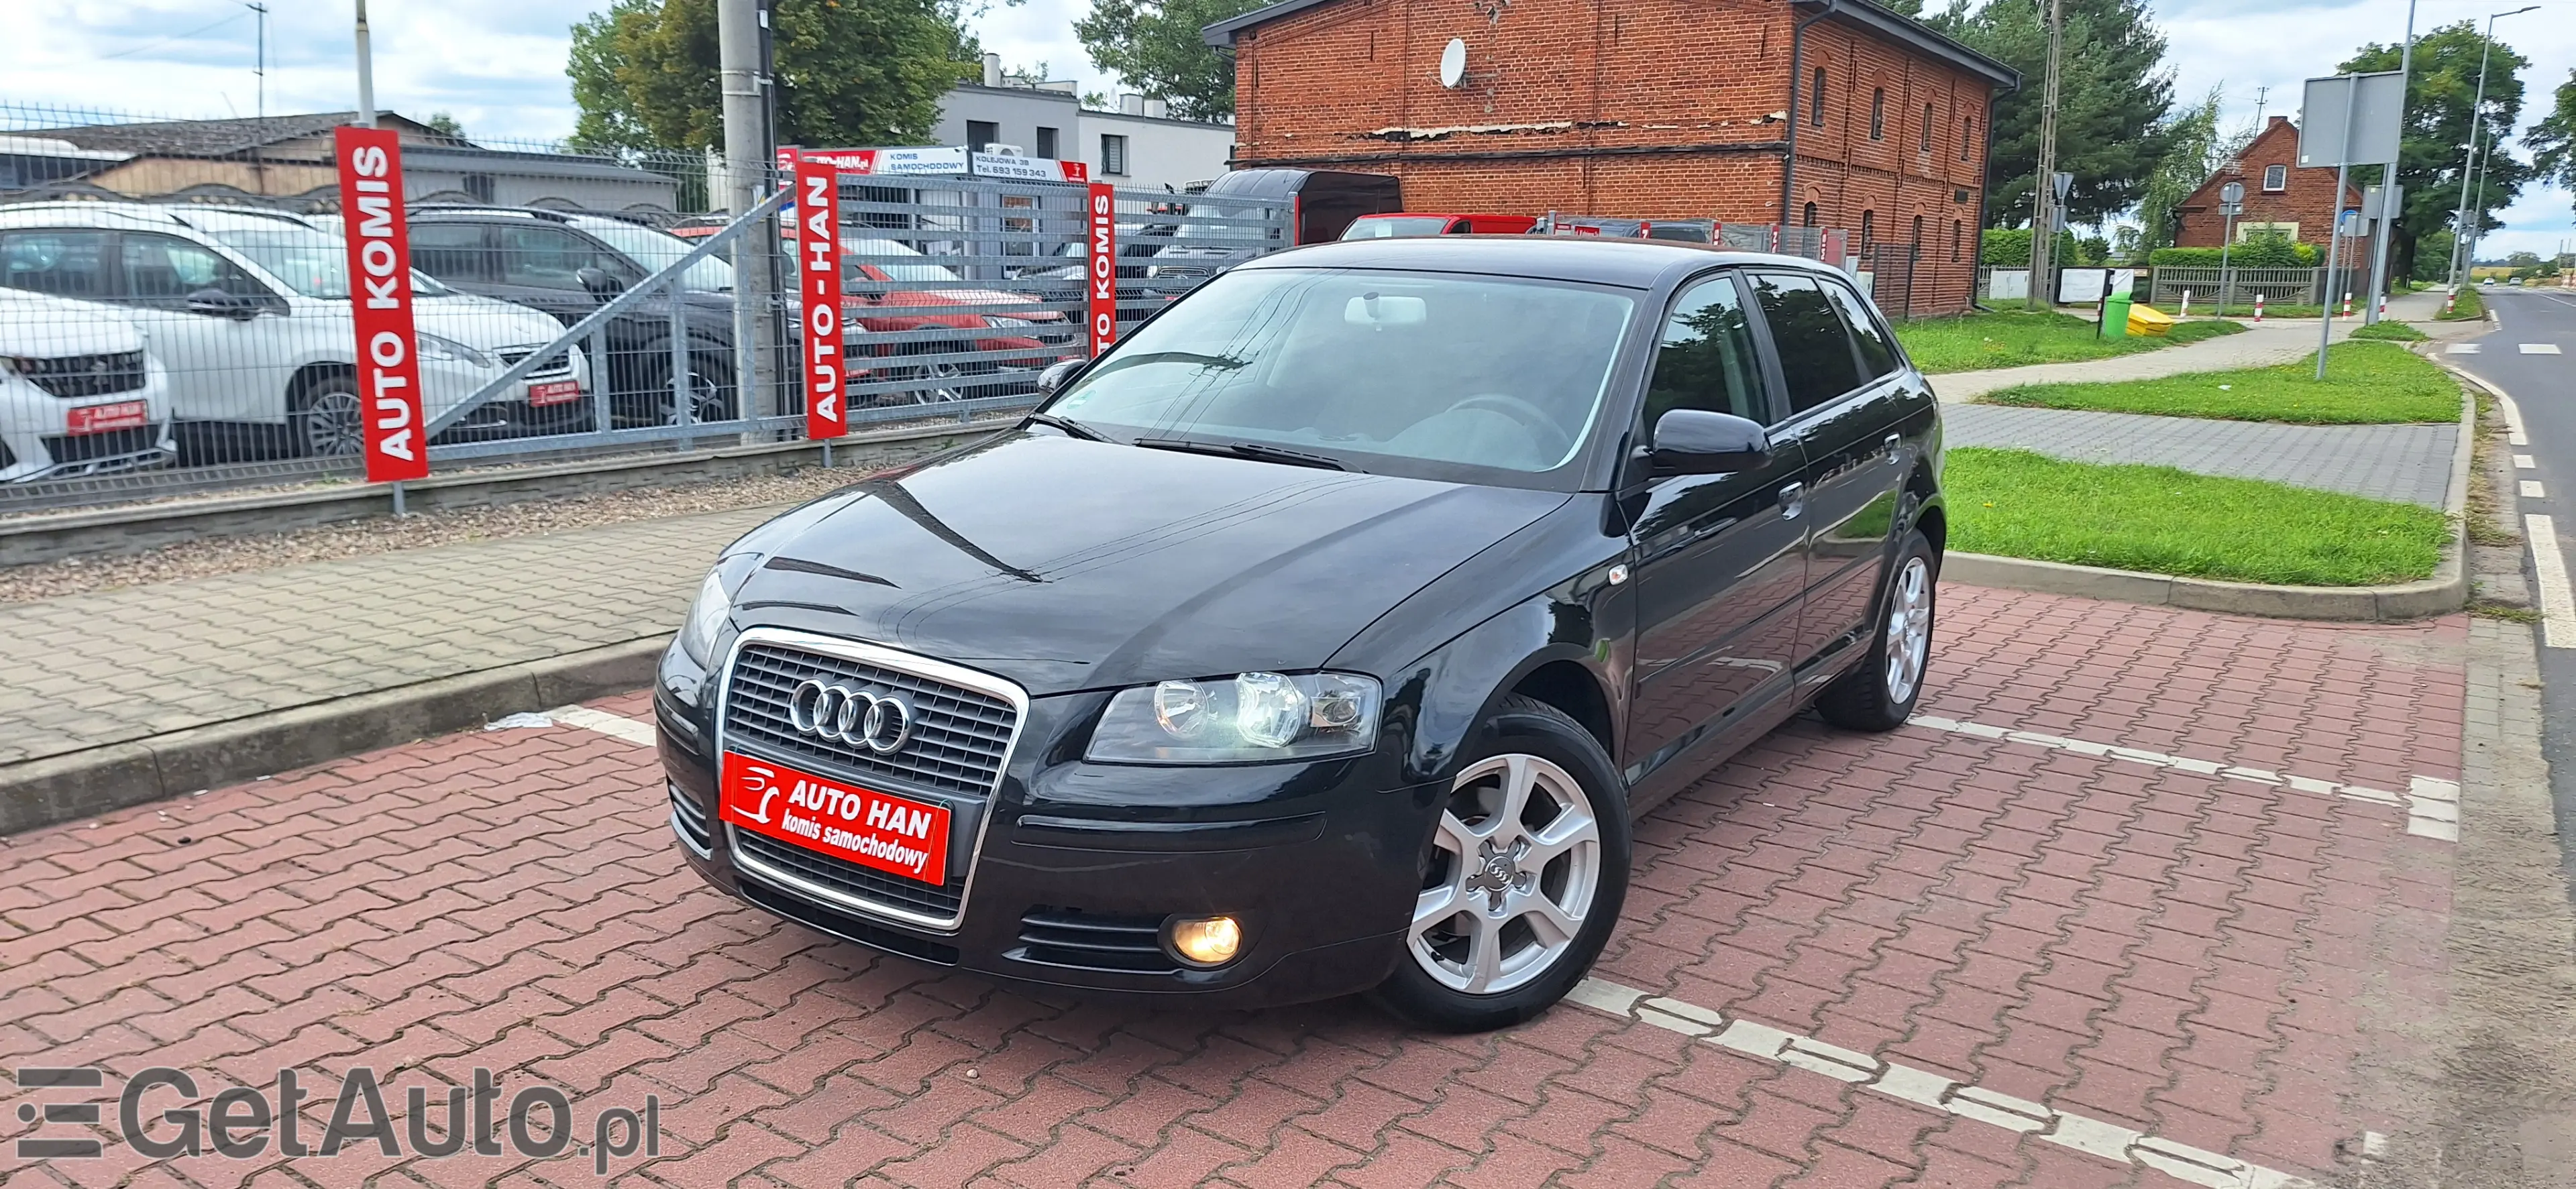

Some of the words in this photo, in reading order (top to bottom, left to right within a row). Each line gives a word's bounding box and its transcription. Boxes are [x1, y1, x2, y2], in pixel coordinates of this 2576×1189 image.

[890, 162, 965, 170] SAMOCHODOWY
[976, 156, 1016, 165] KOLEJOWA
[977, 165, 991, 173] Tel.
[993, 166, 1010, 174] 693
[1012, 168, 1028, 176] 159
[1029, 169, 1046, 177] 343
[352, 145, 400, 310] KOMIS
[1095, 194, 1110, 299] KOMIS
[1097, 313, 1111, 356] TO
[370, 330, 414, 461] AUTO
[788, 779, 862, 821] AUTO
[866, 799, 932, 840] HAN
[782, 808, 822, 840] komis
[822, 826, 928, 874] samochodowy
